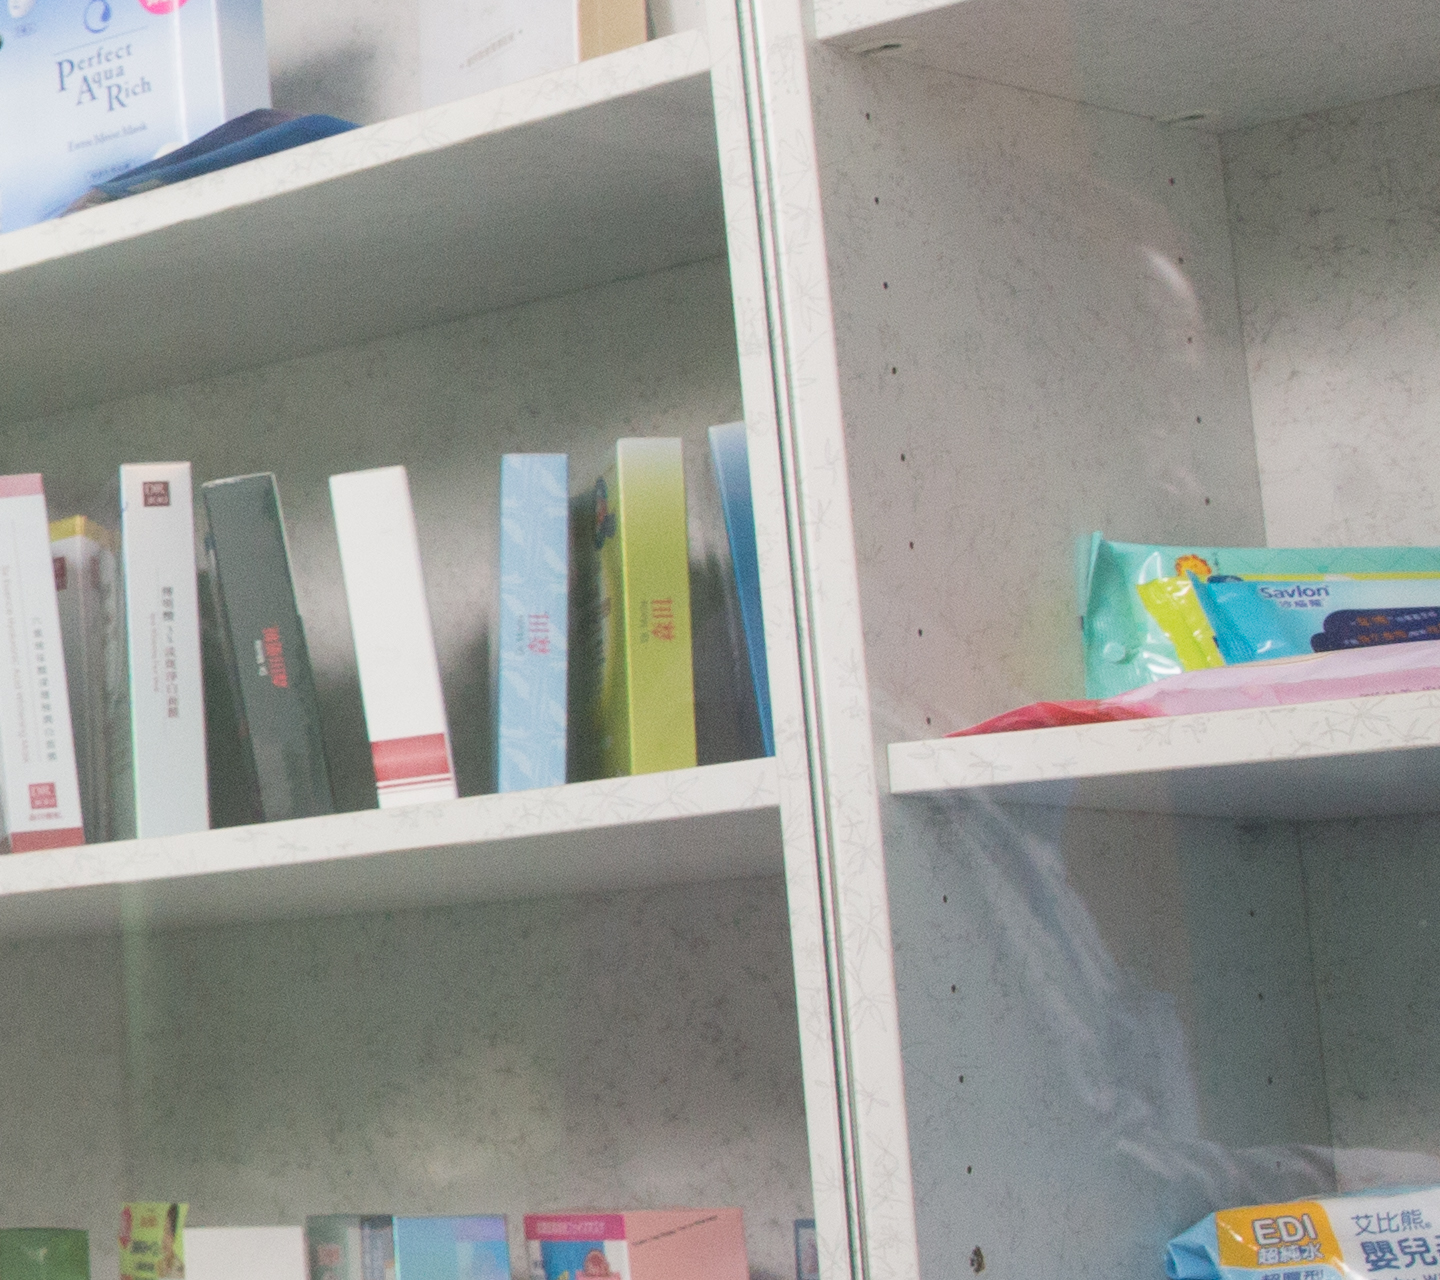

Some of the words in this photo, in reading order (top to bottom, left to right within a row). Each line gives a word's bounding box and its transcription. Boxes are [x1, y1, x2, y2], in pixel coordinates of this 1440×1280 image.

[55, 42, 134, 93] Perfect
[75, 63, 126, 106] Aqua
[104, 76, 153, 113] Rich
[1259, 585, 1330, 599] Savlon
[1251, 1213, 1318, 1246] EDI
[1351, 1208, 1425, 1237] 艾比熊
[1257, 1242, 1325, 1266] 超純水
[1360, 1235, 1440, 1272] 嬰兒
